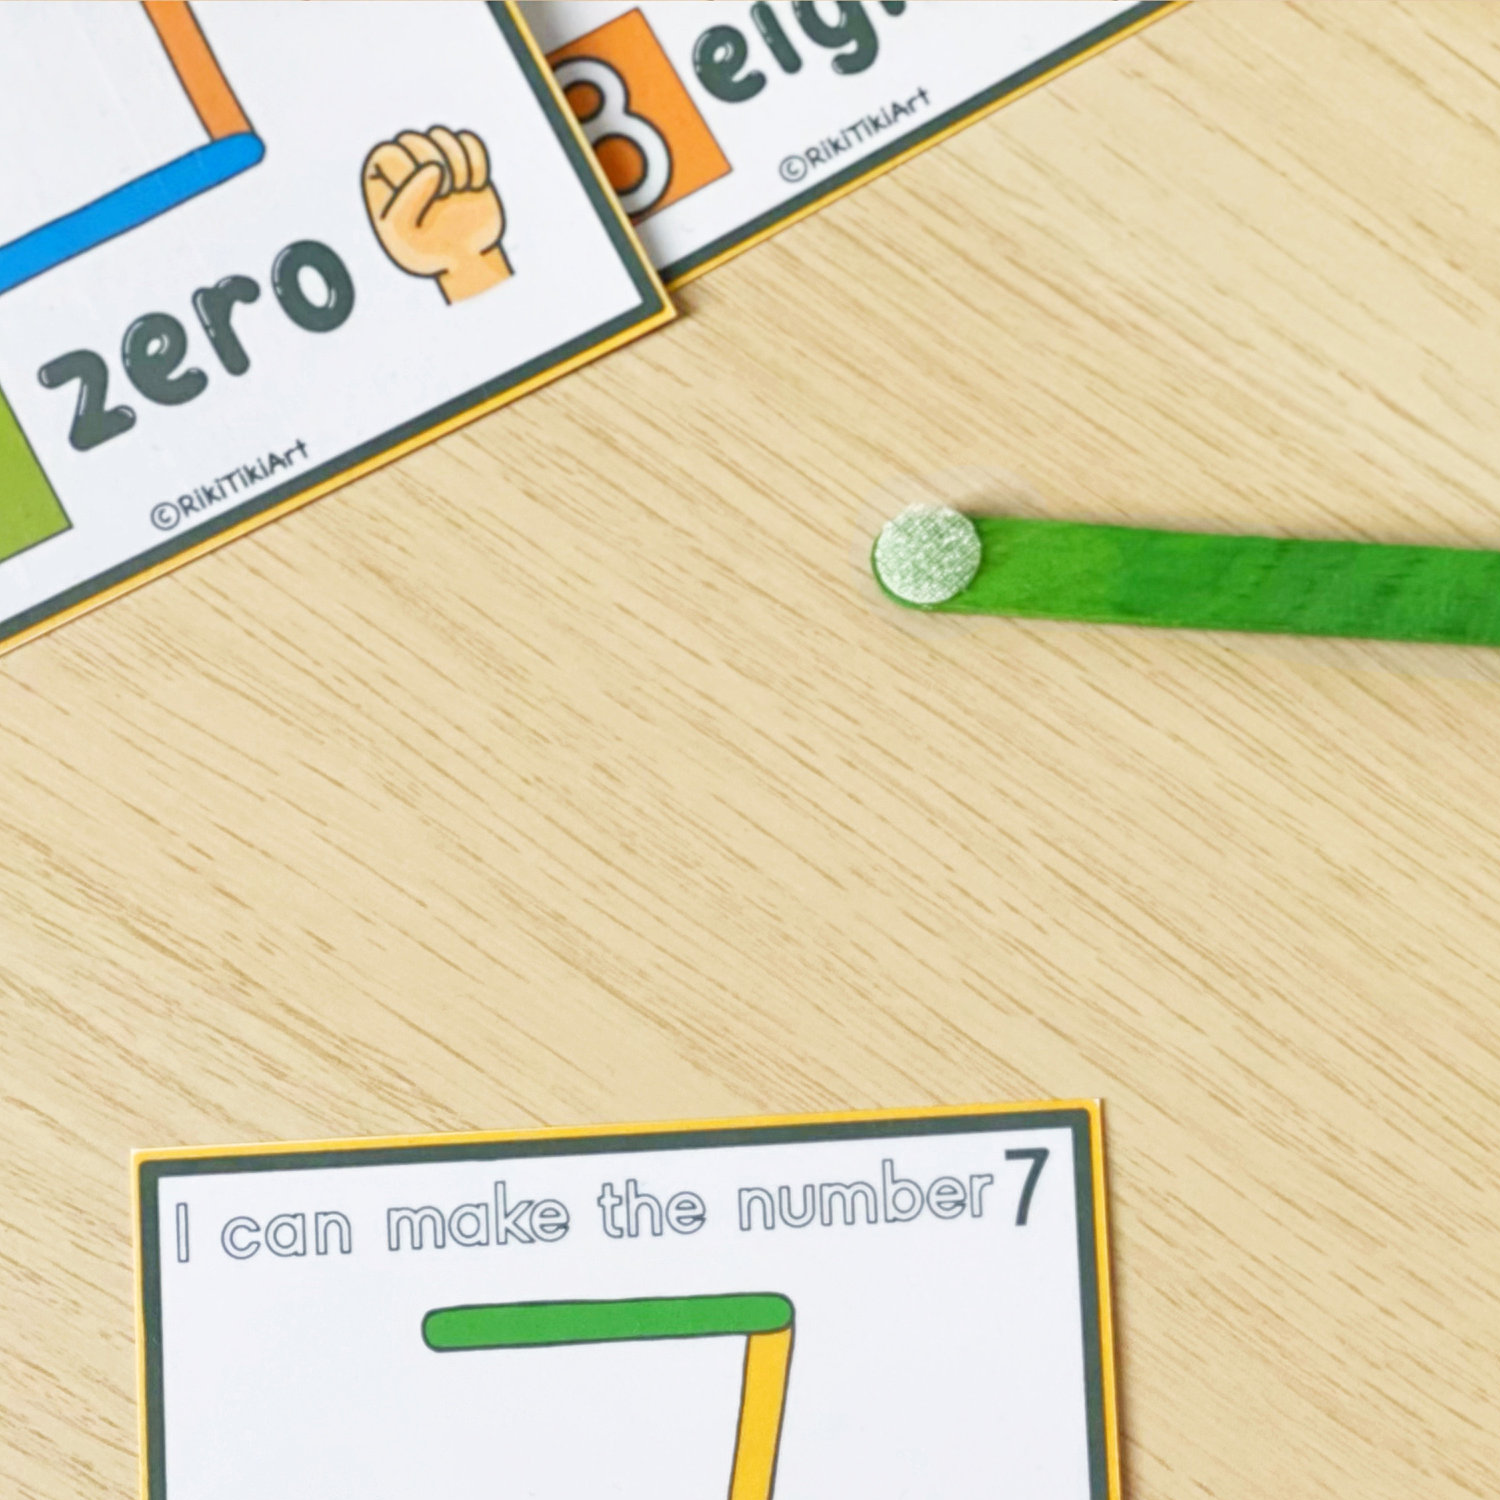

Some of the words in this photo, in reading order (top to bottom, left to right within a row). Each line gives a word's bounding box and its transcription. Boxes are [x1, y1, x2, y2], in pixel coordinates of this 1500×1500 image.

[692, 0, 907, 103] eig
[37, 240, 356, 454] zero
[176, 1202, 189, 1263] I
[221, 1211, 353, 1259] can
[387, 1181, 571, 1251] make
[597, 1179, 707, 1239] the
